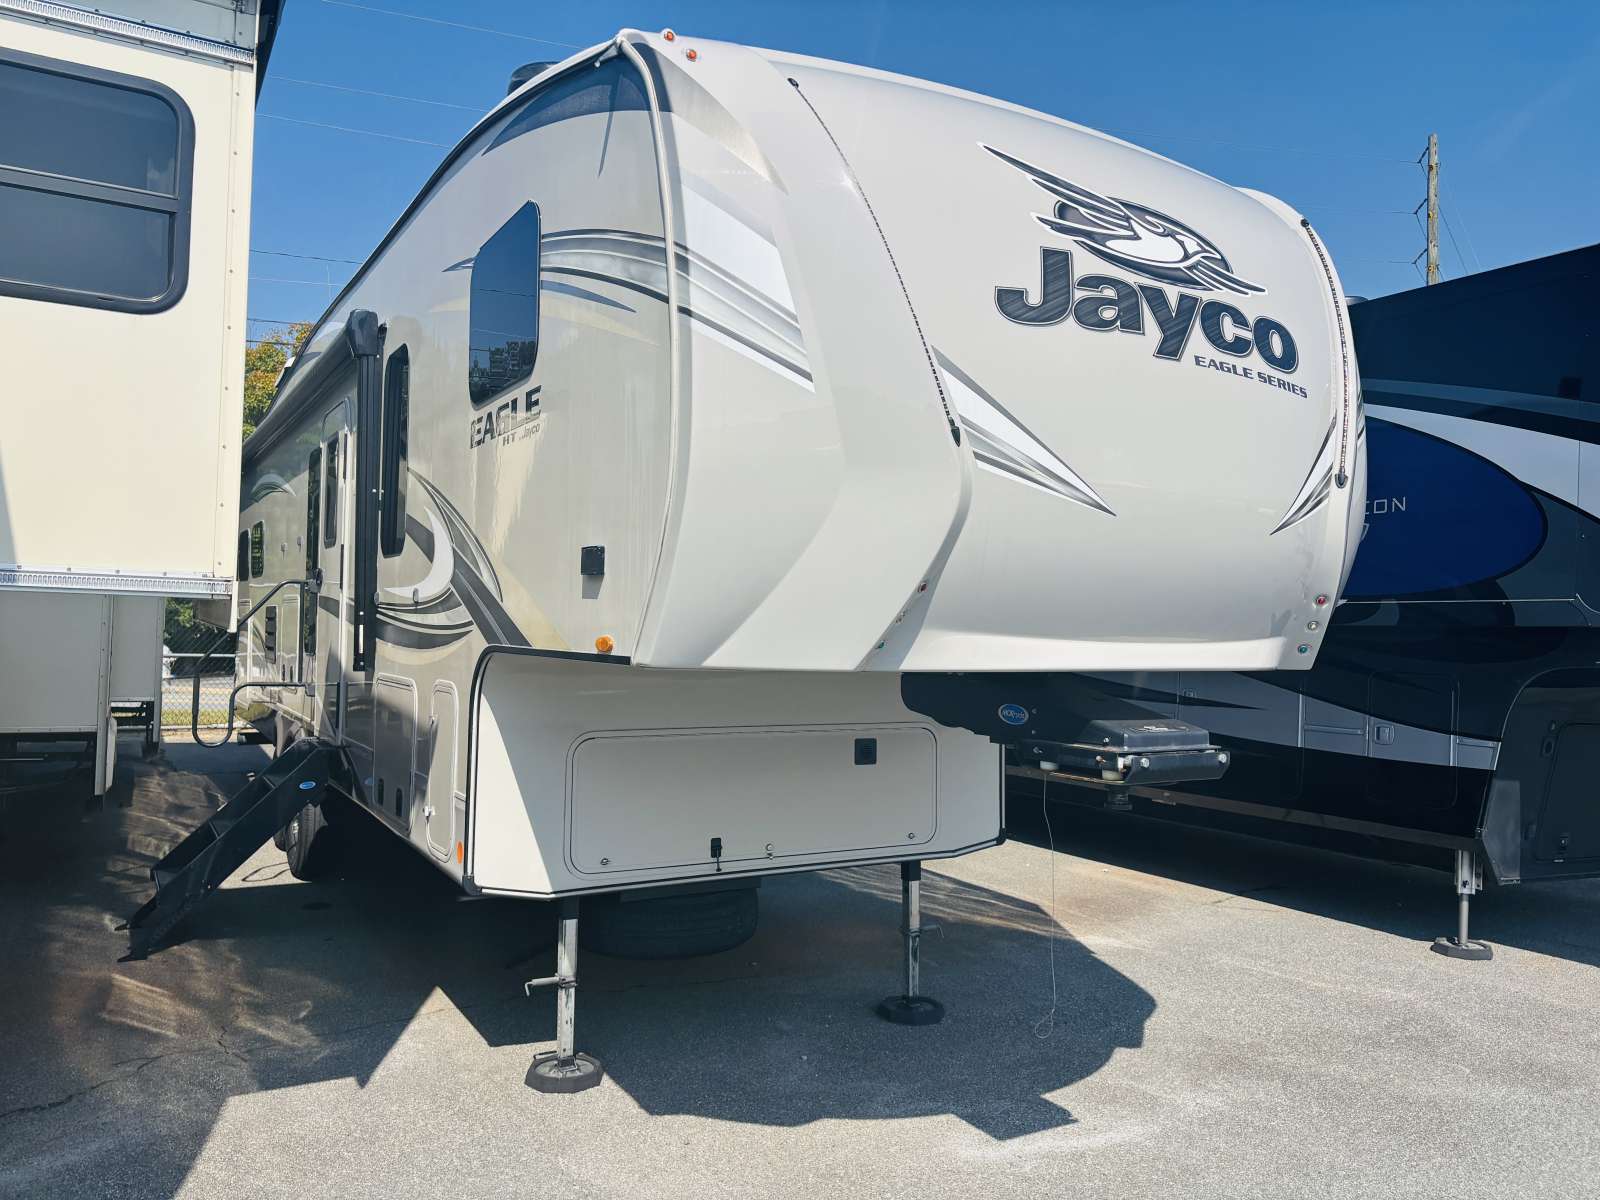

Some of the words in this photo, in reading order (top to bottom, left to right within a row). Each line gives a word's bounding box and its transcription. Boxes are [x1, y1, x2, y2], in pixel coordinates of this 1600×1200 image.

[994, 245, 1299, 374] Jayco
[1194, 355, 1254, 380] EAGLE
[1257, 371, 1308, 399] SERIES
[470, 385, 542, 449] EAGLE
[502, 432, 517, 446] HT
[1365, 496, 1406, 515] ON
